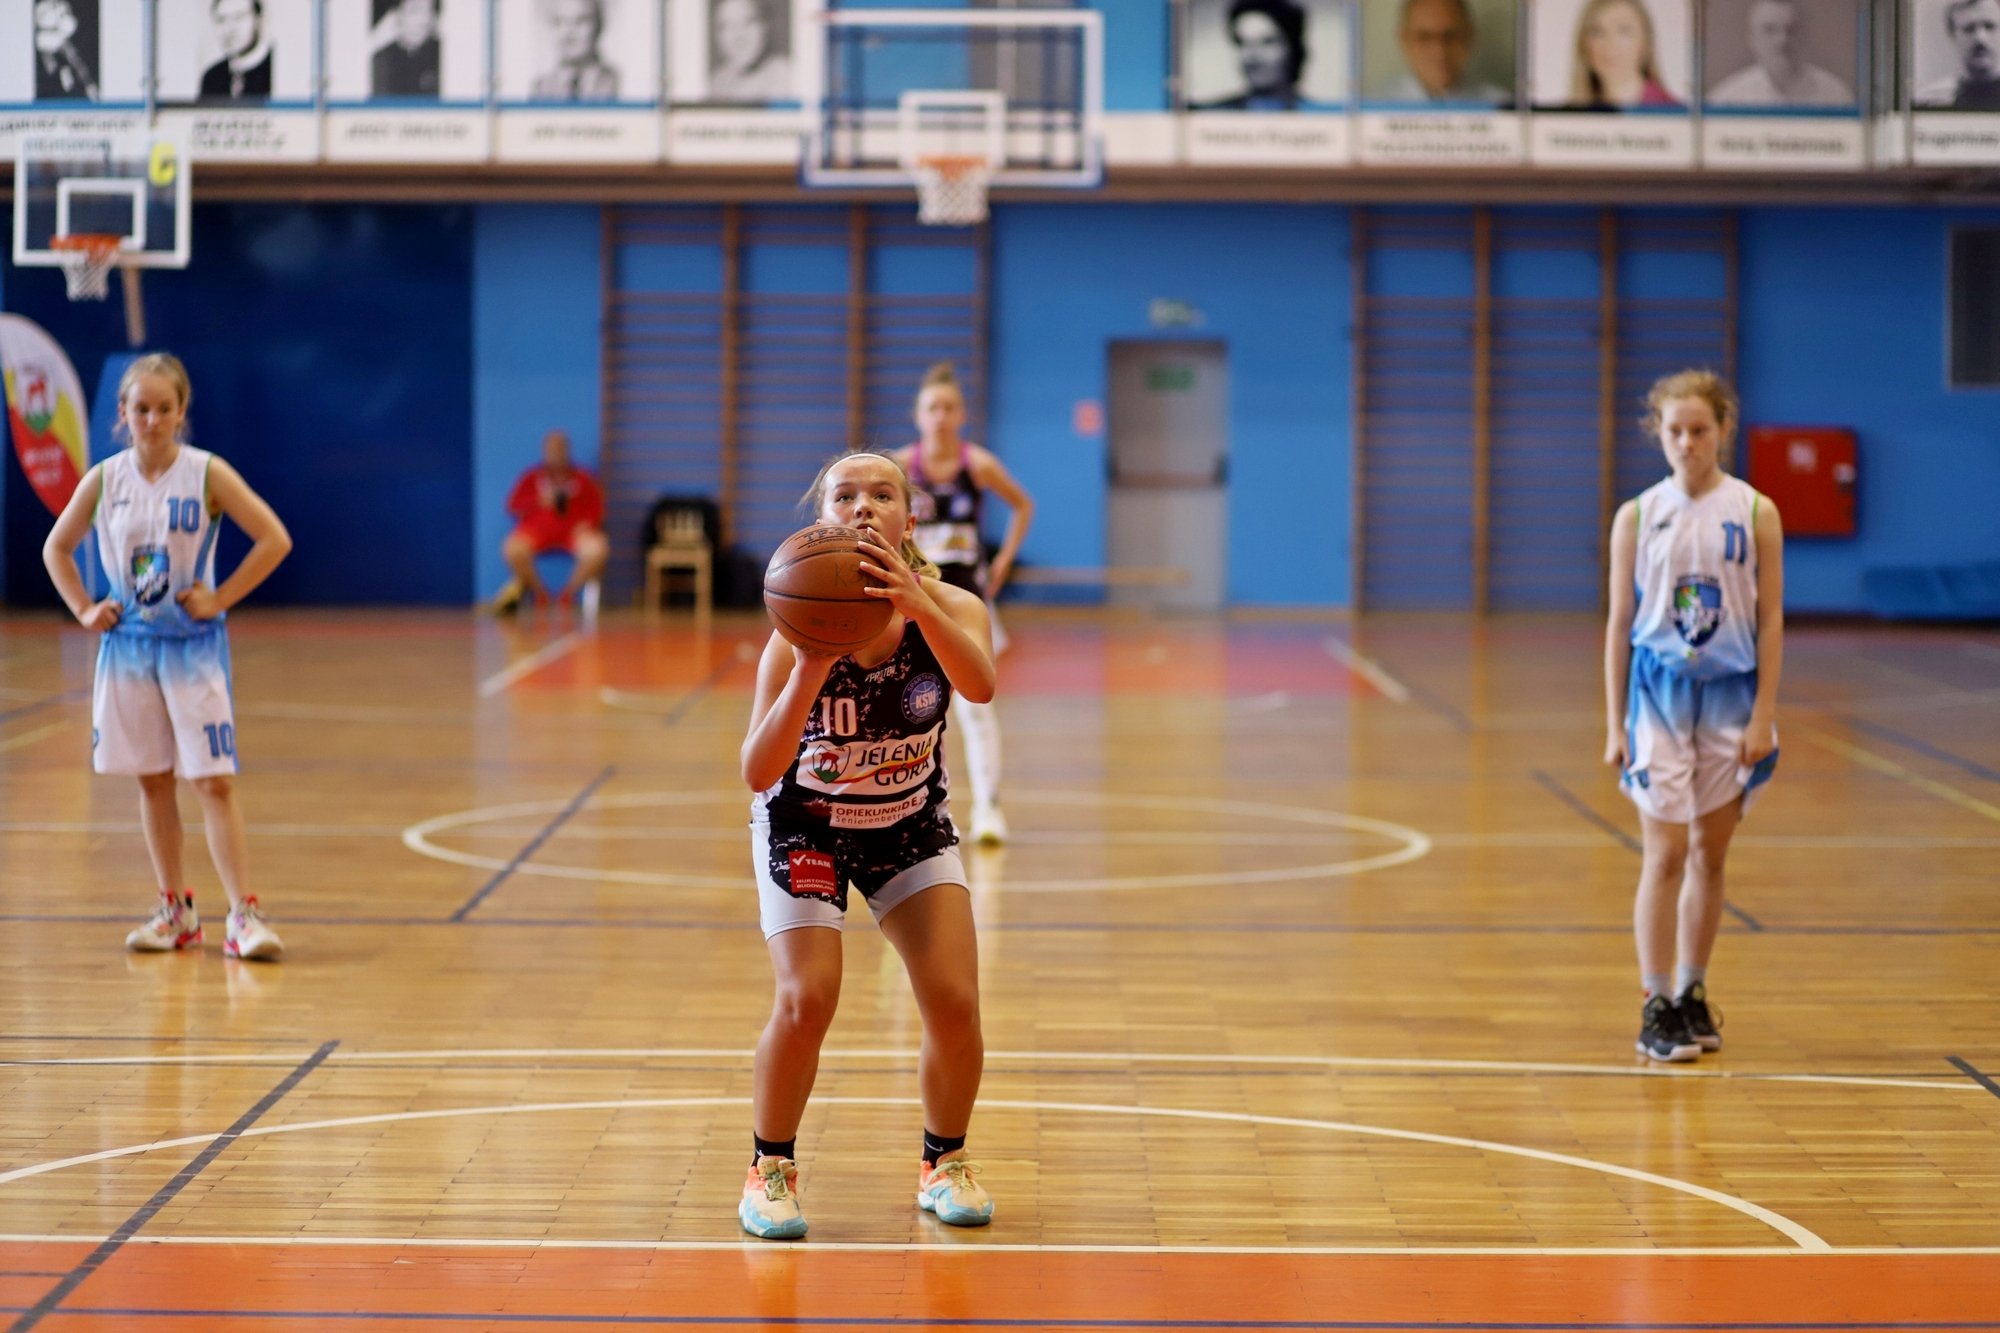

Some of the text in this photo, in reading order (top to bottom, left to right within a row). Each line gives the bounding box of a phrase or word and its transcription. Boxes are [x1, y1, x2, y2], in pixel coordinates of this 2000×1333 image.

[168, 497, 200, 533] 10
[1721, 520, 1747, 565] 11
[915, 690, 937, 709] KSW
[821, 696, 857, 737] 10
[203, 723, 233, 758] 10
[855, 735, 932, 767] JELENIA
[874, 759, 929, 786] GÓRA
[805, 858, 831, 868] TEAM
